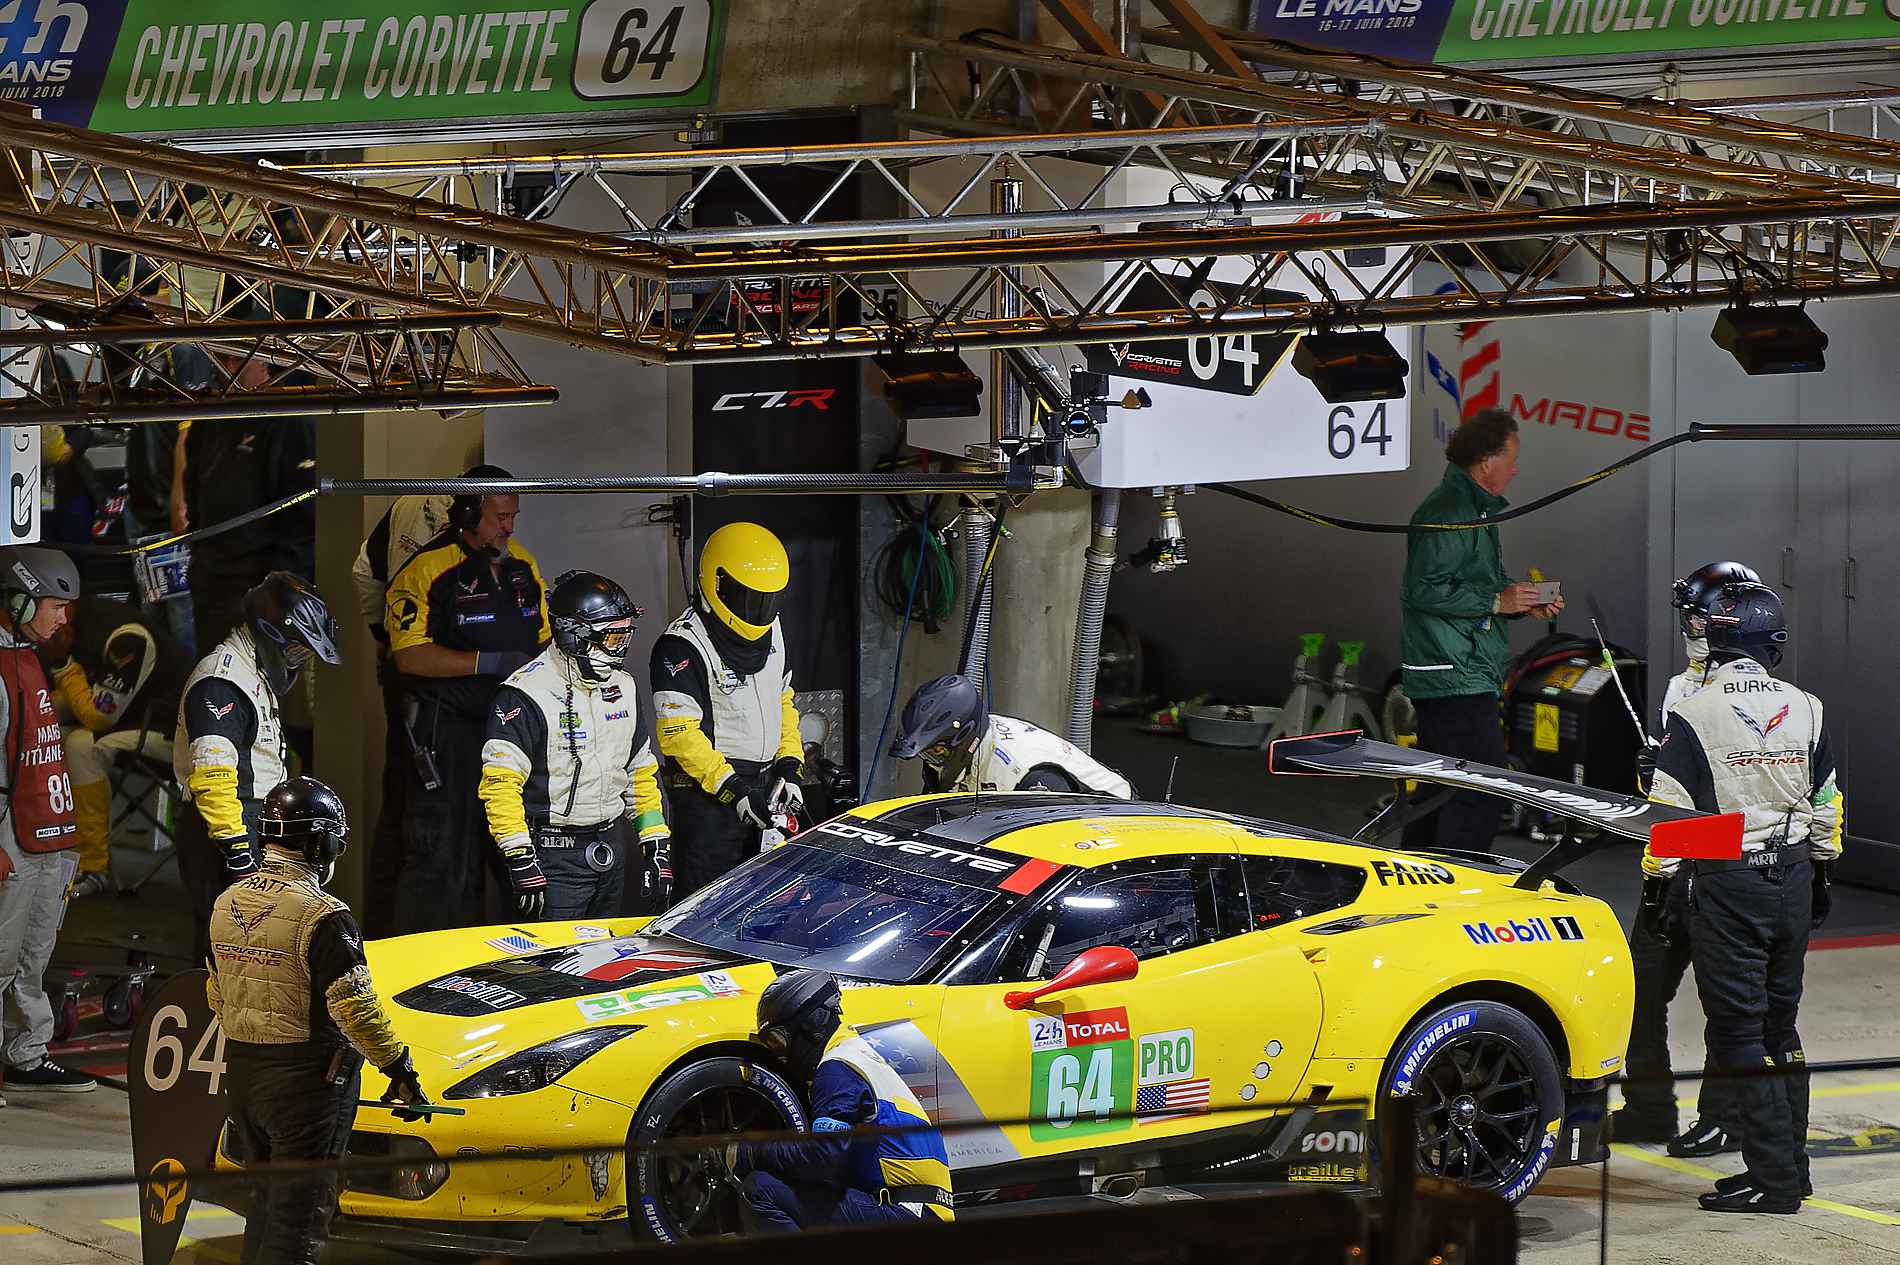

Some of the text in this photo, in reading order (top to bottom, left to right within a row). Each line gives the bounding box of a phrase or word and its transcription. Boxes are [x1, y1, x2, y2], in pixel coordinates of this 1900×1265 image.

[1276, 0, 1317, 18] LE
[1318, 16, 1416, 32] 16-17 JUIN 2018
[600, 5, 679, 83] 64
[126, 9, 570, 110] CHEVROLET CORVETTE
[33, 85, 65, 98] 2018
[1127, 353, 1183, 367] CORVETTE
[1128, 361, 1181, 375] RACING
[1327, 402, 1393, 459] 64
[1509, 393, 1650, 442] MADE
[1723, 680, 1784, 694] BURKE
[1727, 758, 1806, 767] RACING
[48, 772, 74, 815] 89
[816, 822, 1016, 873] CORVETTE
[1370, 860, 1454, 887] FARO
[1462, 917, 1578, 945] Mobil 1
[216, 944, 287, 960] CORVETTE
[216, 951, 281, 967] RACING
[1067, 1021, 1128, 1039] TOTAL
[144, 1004, 227, 1095] 64
[1141, 1036, 1191, 1078] PRO
[1402, 1013, 1470, 1078] MICHELIN
[1047, 1048, 1115, 1129] 64
[1287, 1163, 1355, 1176] braille
[1504, 1151, 1548, 1203] MICHE
[644, 1203, 673, 1244] HELIN
